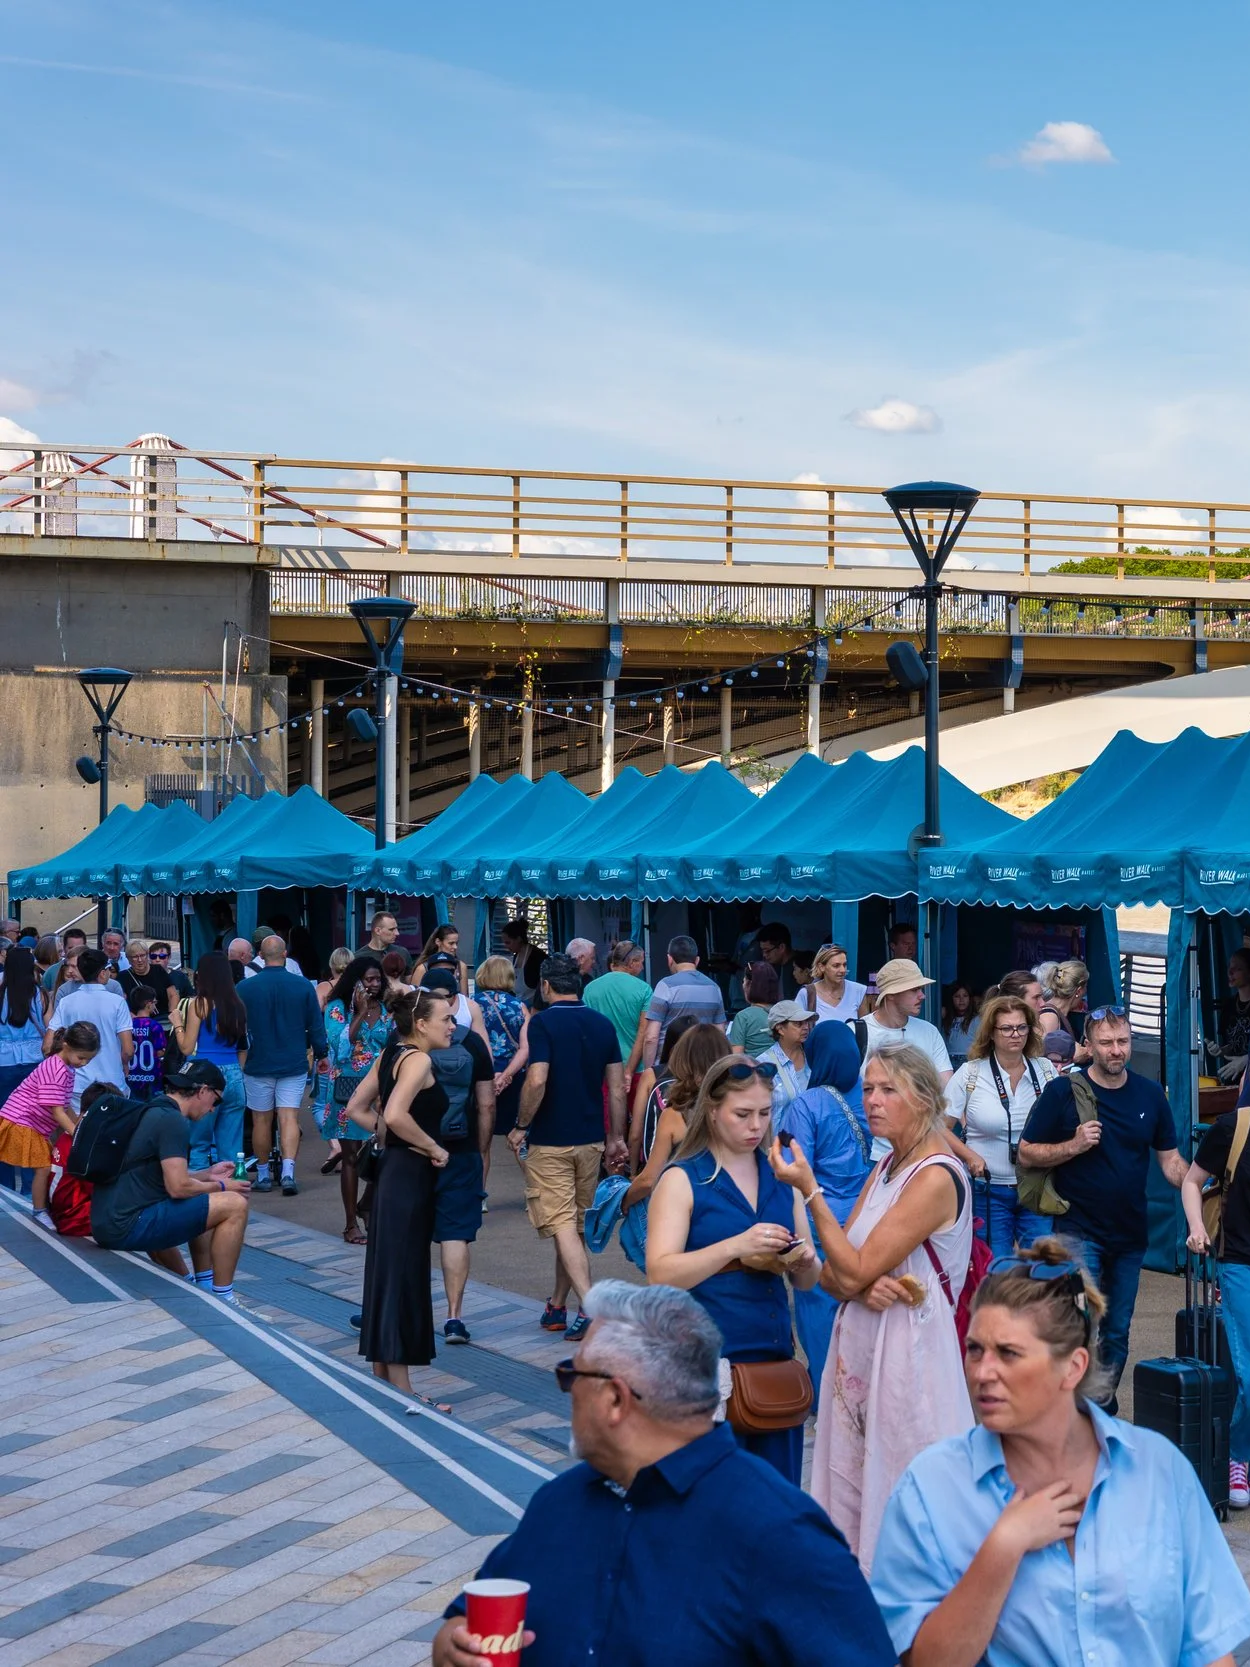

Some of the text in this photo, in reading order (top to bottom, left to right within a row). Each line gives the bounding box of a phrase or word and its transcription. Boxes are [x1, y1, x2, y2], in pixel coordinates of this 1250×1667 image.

[943, 866, 956, 875] WALK
[988, 867, 1002, 878] RIVER
[1003, 867, 1020, 877] WALK
[1050, 869, 1066, 880] RIVER
[1066, 867, 1080, 878] WALK
[1120, 867, 1135, 878] RIVER
[1136, 864, 1151, 876] WALK
[1200, 869, 1216, 882] RIVER
[1217, 870, 1236, 881] WALK
[995, 1074, 1005, 1094] SONY
